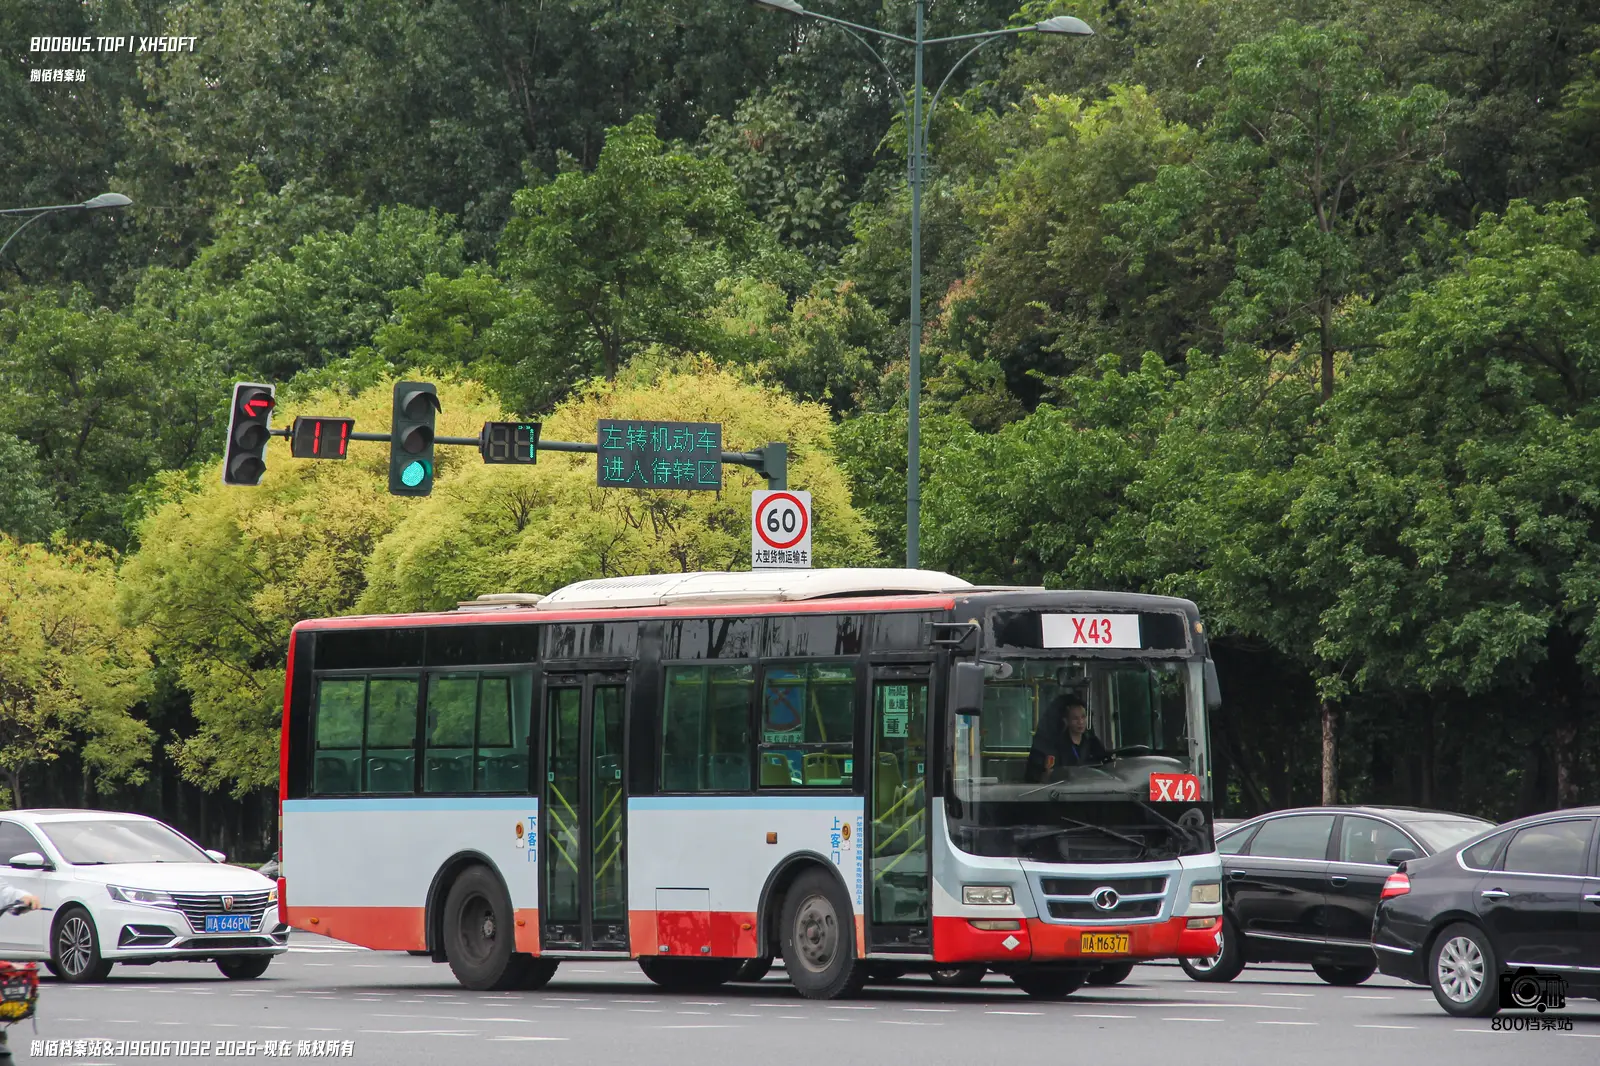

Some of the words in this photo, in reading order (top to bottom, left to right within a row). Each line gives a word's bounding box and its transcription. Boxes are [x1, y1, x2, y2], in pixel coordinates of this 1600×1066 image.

[602, 424, 717, 453] 左转机动车
[766, 508, 796, 533] 60
[755, 550, 808, 565] 大型货物运输车
[1072, 617, 1113, 644] X43
[1155, 779, 1196, 802] X42
[527, 816, 537, 863] 下客门
[830, 816, 841, 865] 上客门
